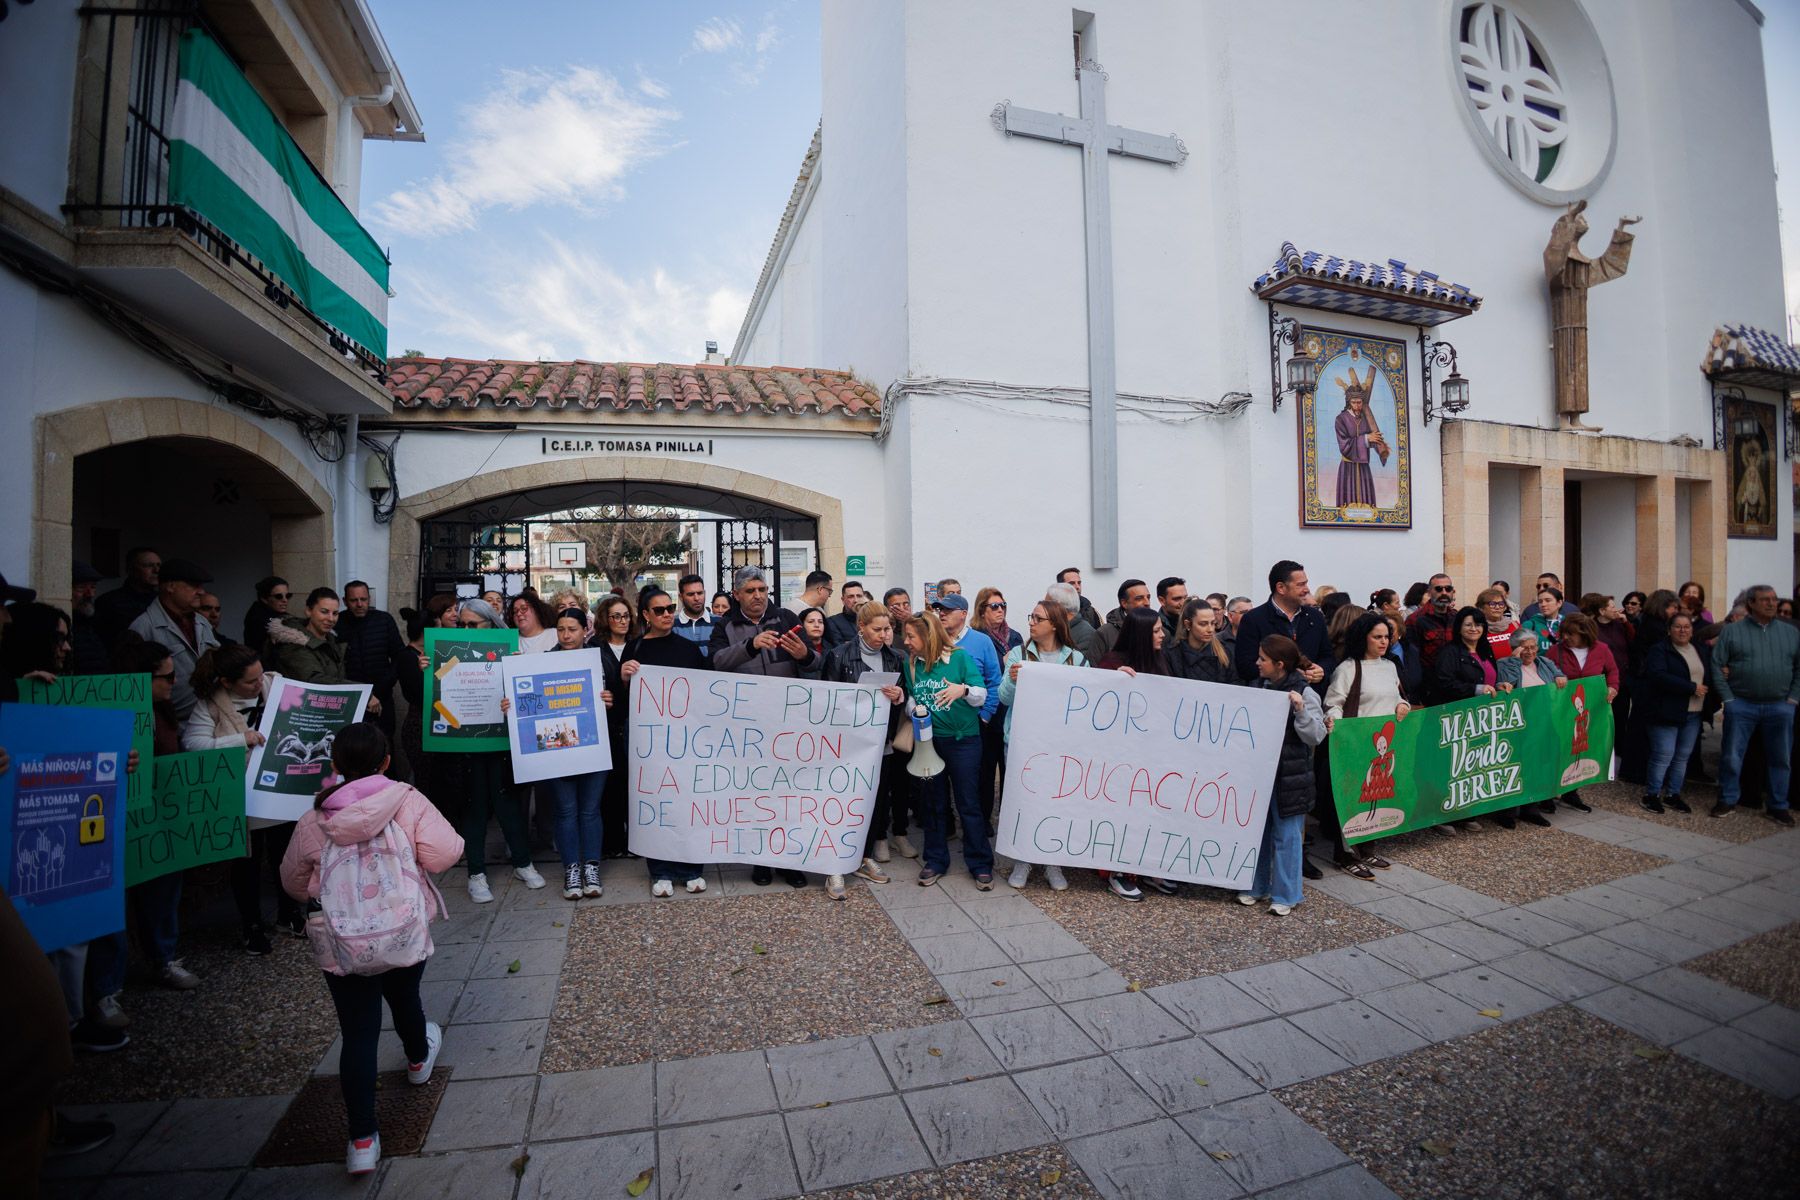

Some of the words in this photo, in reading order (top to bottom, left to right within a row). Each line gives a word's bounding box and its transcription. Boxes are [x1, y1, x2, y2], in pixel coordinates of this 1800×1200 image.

[551, 440, 594, 451] C.E.I.P.
[598, 440, 652, 452] TOMASA
[655, 440, 705, 452] PINILLA
[548, 696, 581, 710] DERECHO
[637, 676, 691, 719] NO
[705, 679, 758, 721] SE
[783, 684, 888, 728] PUEDE
[1065, 685, 1149, 735] POR
[1173, 697, 1255, 749] UNA
[1439, 699, 1524, 745] MAREA
[636, 723, 765, 760] JUGAR
[772, 731, 842, 763] CON
[1450, 731, 1511, 778] Verde
[21, 759, 44, 774] MÁS
[45, 757, 92, 774] NIÑOS/AS
[163, 752, 236, 789] AULA
[637, 766, 680, 795] LA
[692, 762, 875, 794] EDUCACIÓN
[19, 794, 41, 809] MÁS
[42, 793, 80, 807] TOMASA
[187, 787, 221, 816] EN
[1020, 752, 1257, 828] EDUCACIÓN
[1443, 765, 1522, 811] JEREZ
[638, 801, 676, 828] DE
[691, 796, 865, 828] NUESTROS
[128, 815, 246, 869] TOMASA
[710, 827, 858, 865] HIJOS/AS
